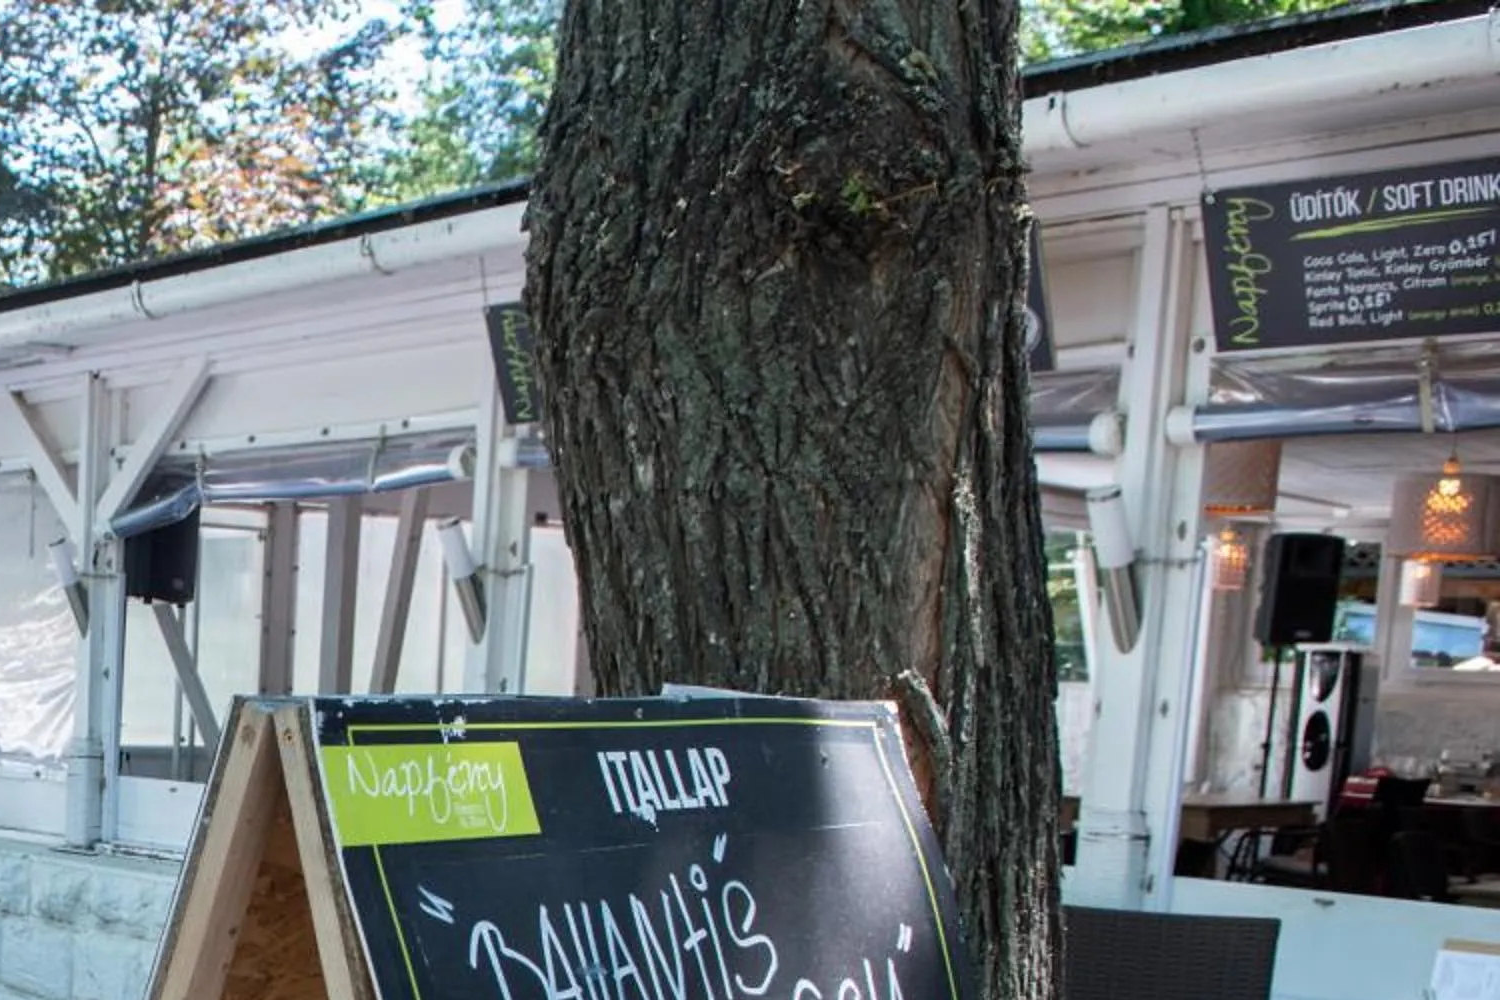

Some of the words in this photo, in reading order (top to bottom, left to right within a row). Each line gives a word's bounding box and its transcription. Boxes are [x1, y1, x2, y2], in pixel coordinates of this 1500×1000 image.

[1383, 181, 1434, 212] SOFT
[1303, 254, 1334, 268] Coca
[1413, 243, 1446, 258] Zero
[1369, 308, 1403, 327] Light
[597, 747, 731, 813] ITALLAP
